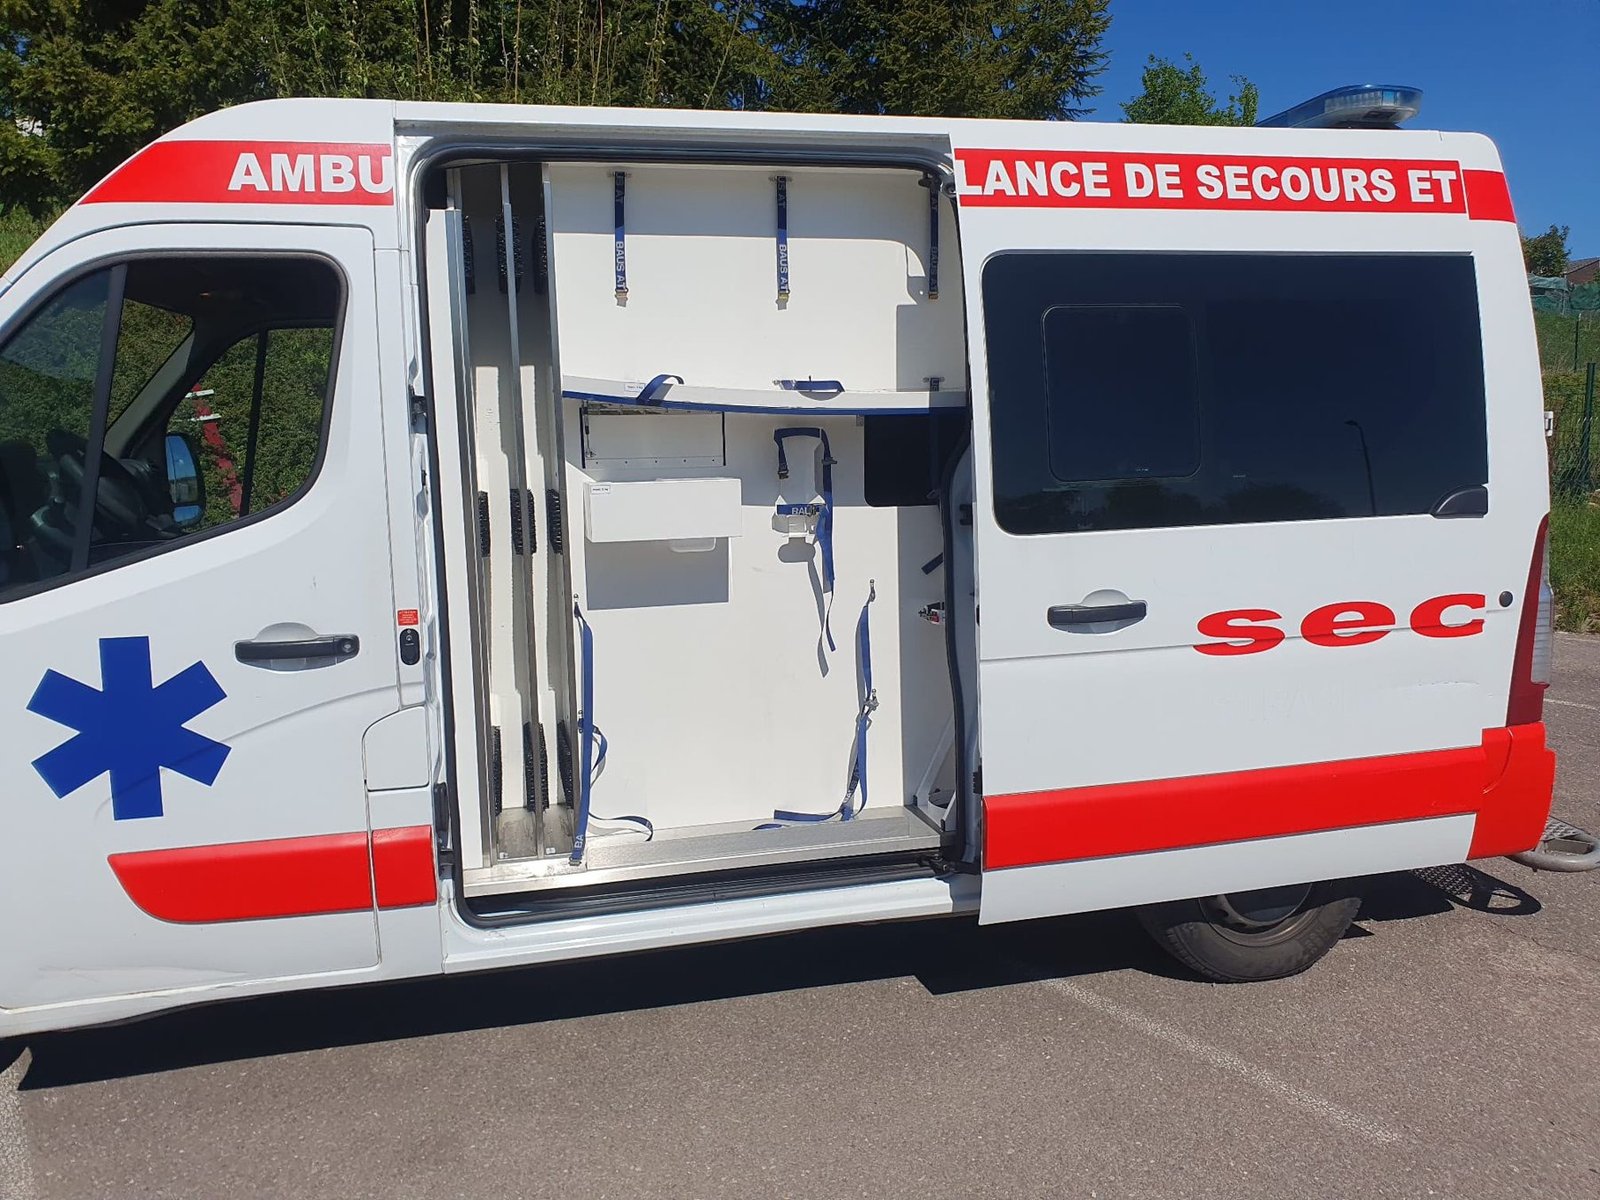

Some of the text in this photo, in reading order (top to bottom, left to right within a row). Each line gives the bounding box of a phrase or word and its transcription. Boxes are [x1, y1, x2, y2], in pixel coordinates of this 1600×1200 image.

[227, 152, 394, 194] AMBU
[955, 160, 1457, 203] LANCE DE SECOURS ET
[615, 241, 626, 289] BAUS AT
[779, 243, 789, 290] BAUS AT
[1193, 593, 1486, 656] sec
